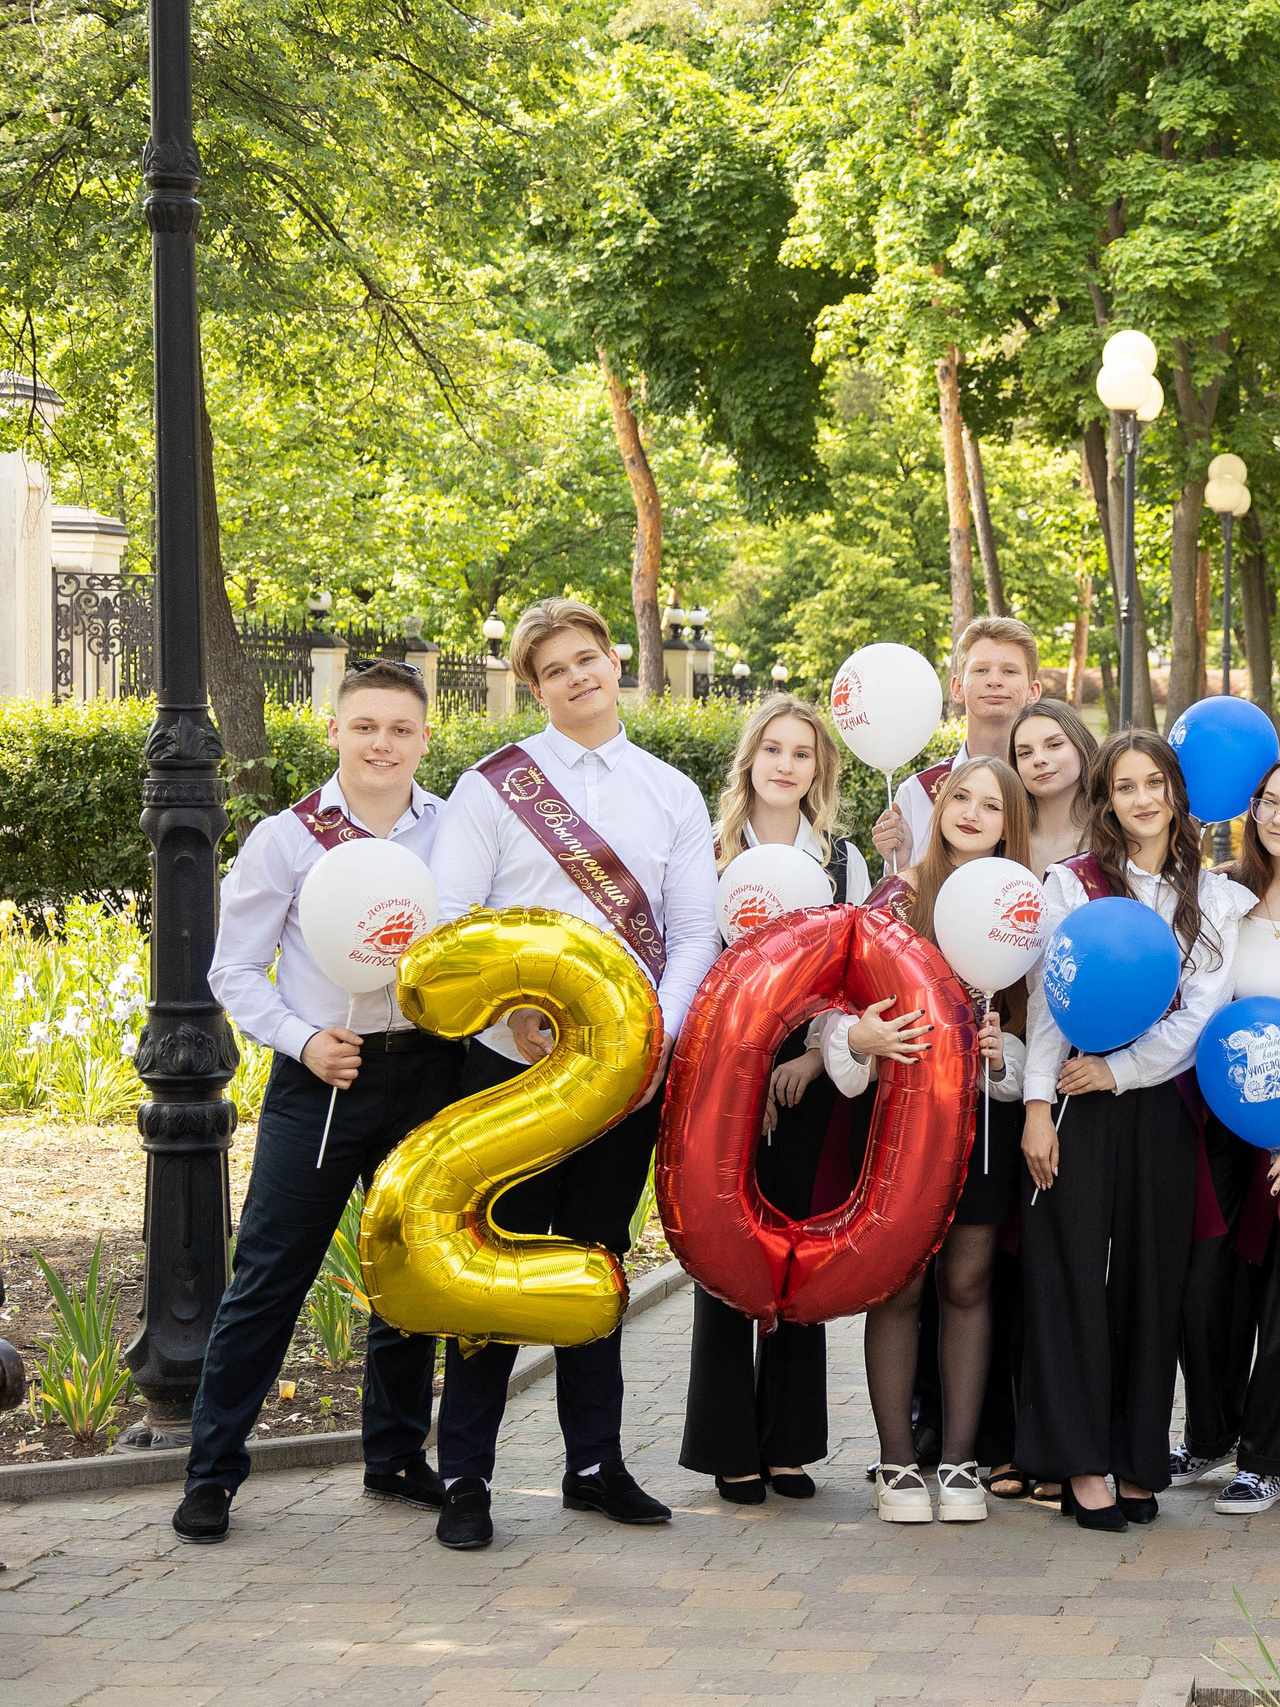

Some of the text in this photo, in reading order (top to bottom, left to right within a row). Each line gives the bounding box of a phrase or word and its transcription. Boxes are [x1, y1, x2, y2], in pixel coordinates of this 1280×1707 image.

[519, 775, 535, 788] 11
[534, 798, 630, 907] Выпускник
[566, 863, 594, 890] МБОУ
[728, 884, 764, 903] ДОБРЫЙ
[1001, 880, 1034, 897] ДОБРЫЙ
[367, 898, 411, 920] ДОБРЫЙ
[1247, 1035, 1280, 1054] Спасибо
[359, 906, 664, 1347] 2
[656, 904, 979, 1326] 0
